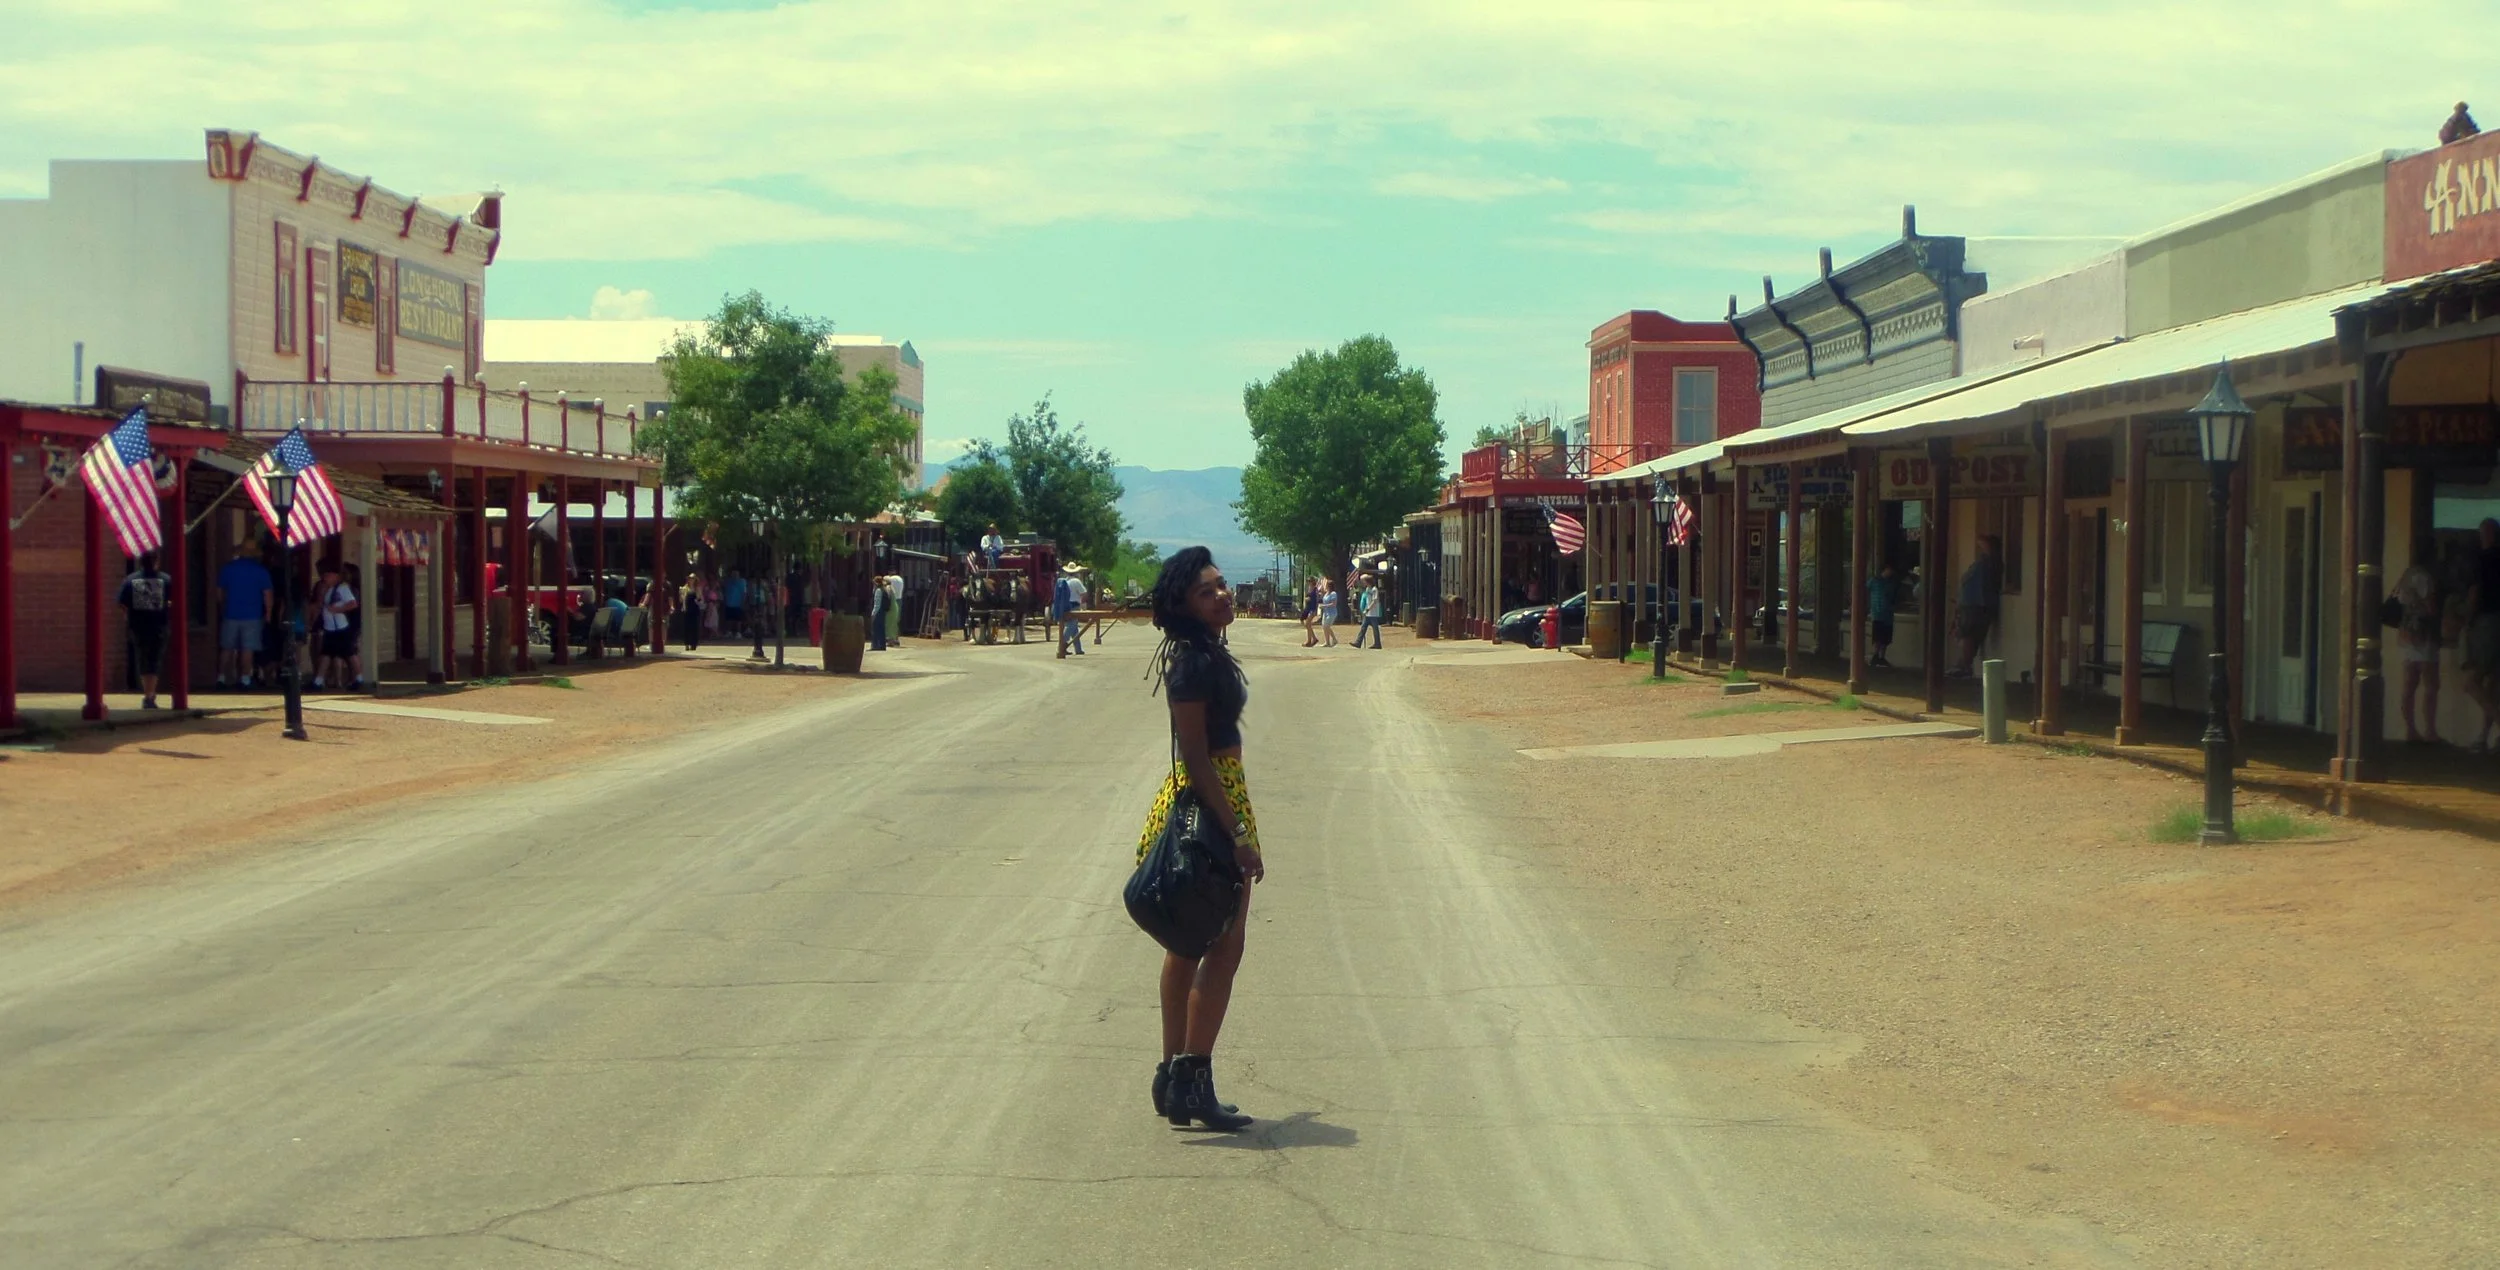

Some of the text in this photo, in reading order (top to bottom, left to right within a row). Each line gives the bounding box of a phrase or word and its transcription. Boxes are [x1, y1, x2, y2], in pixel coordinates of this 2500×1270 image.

[400, 266, 460, 312] LONGHORN
[400, 298, 463, 342] RESTAURANT
[1890, 455, 2027, 487] OUPOST
